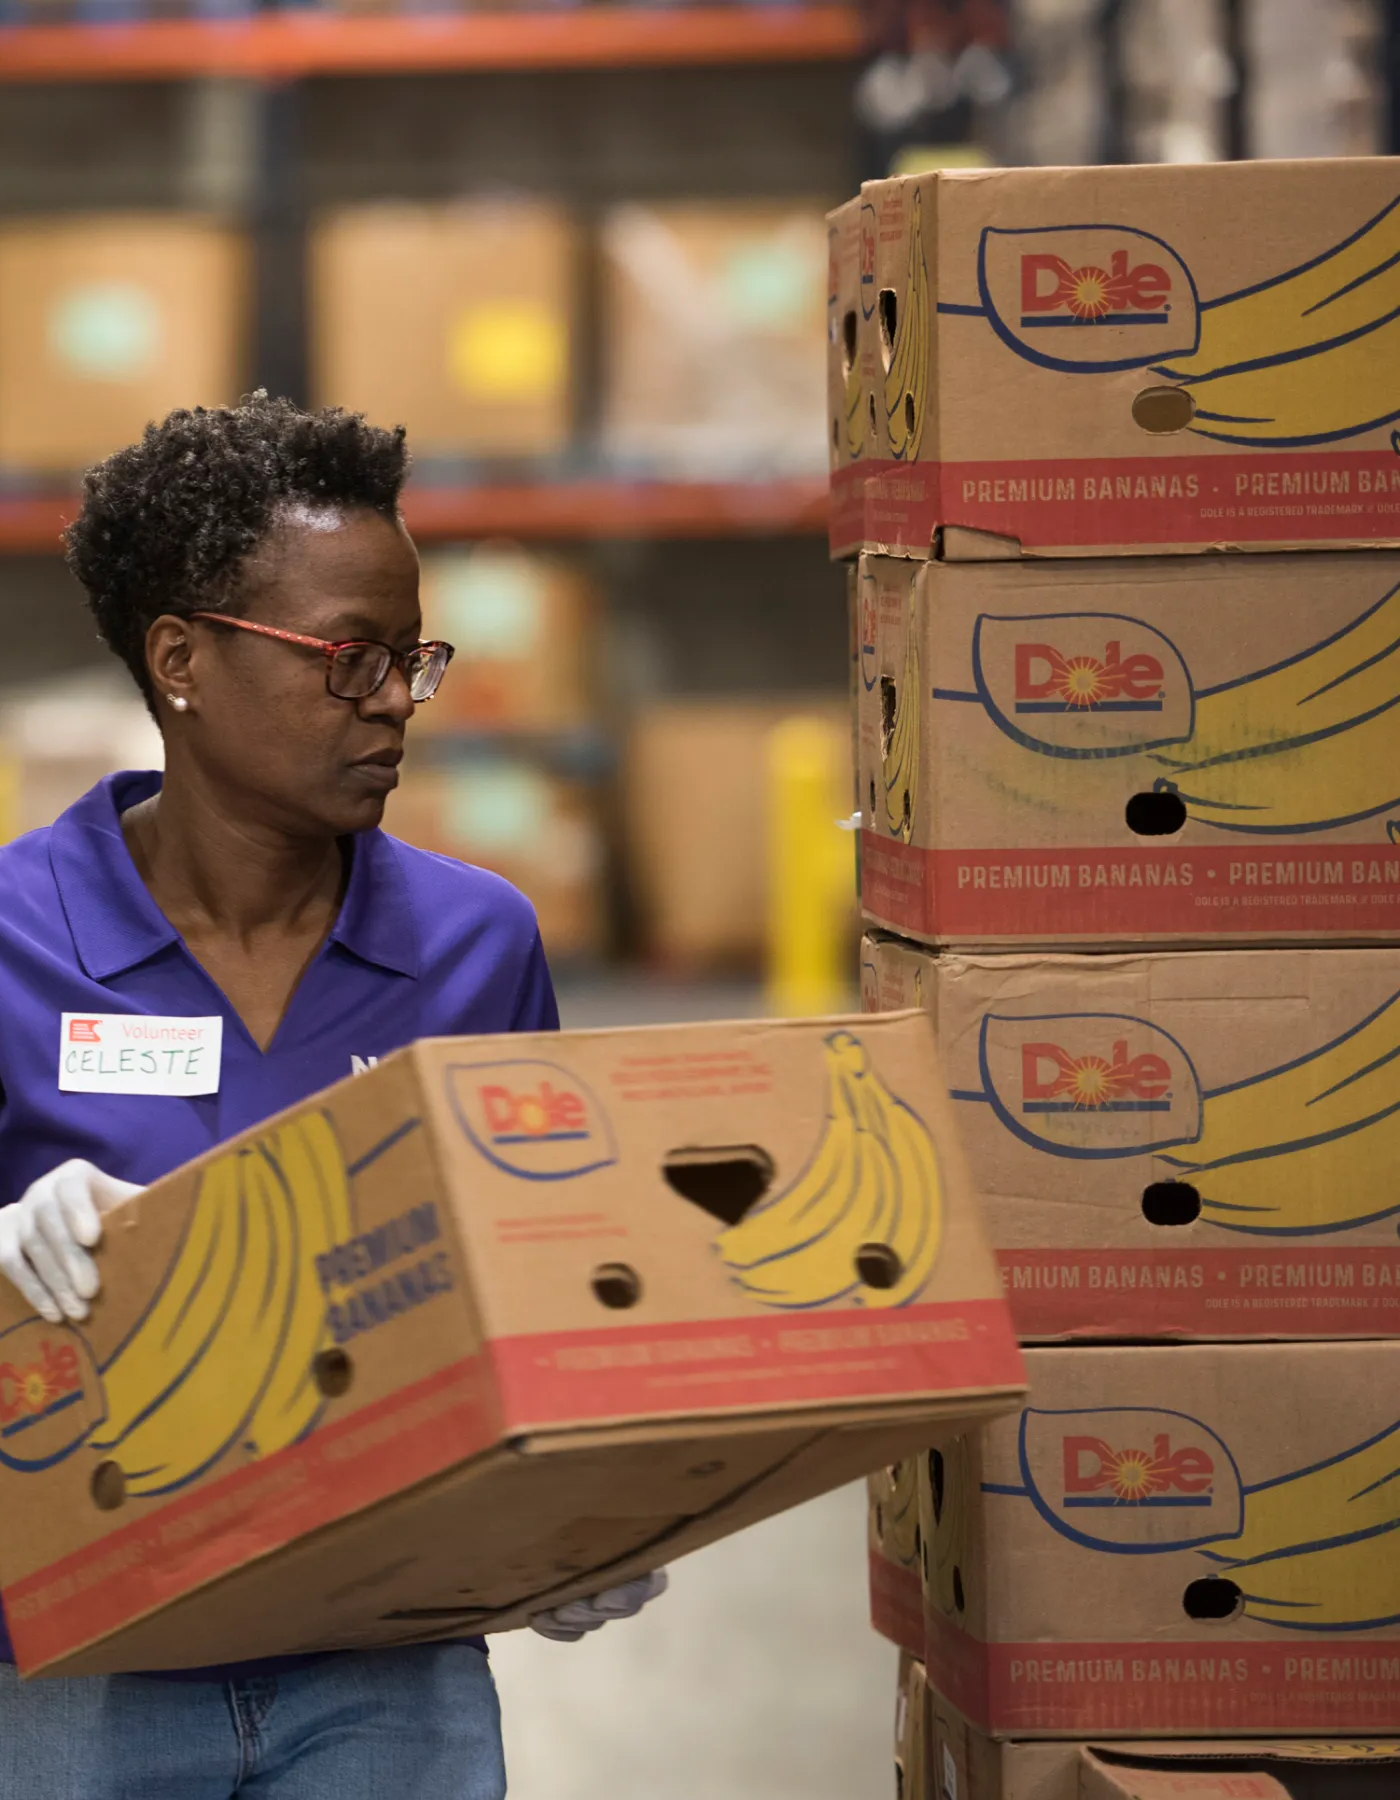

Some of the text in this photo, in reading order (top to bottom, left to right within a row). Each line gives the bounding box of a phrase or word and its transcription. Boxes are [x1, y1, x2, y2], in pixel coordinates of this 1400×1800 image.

[1020, 250, 1172, 318] Dole
[962, 478, 1076, 503] PREMIUM
[1084, 475, 1199, 500] BANANAS
[1235, 471, 1350, 496] PREMIUM
[1200, 507, 1224, 518] DOLE
[1226, 507, 1236, 518] IS
[1238, 507, 1245, 517] A
[1247, 505, 1303, 517] REGISTERED
[1306, 503, 1363, 516] TRADEMARK
[1014, 641, 1164, 706] Dole
[957, 860, 1400, 889] PREMIUM BANANAS PREMIUM BAN
[1195, 895, 1218, 906] DOLE
[1232, 895, 1239, 905] A
[1242, 894, 1298, 906] REGISTERED
[1299, 893, 1358, 905] TRADEMARK
[1371, 893, 1395, 904] DOLE
[122, 1021, 206, 1040] Volunteer
[65, 1047, 204, 1074] CELESTE
[1021, 1040, 1172, 1106] Dole
[478, 1080, 587, 1137] Dole
[1088, 1264, 1204, 1289] BANANAS
[1239, 1263, 1354, 1288] PREMIUM
[1205, 1298, 1229, 1309] DOLE
[1243, 1298, 1250, 1308] A
[1252, 1297, 1308, 1308] REGISTERED
[1311, 1297, 1368, 1308] TRADEMARK
[1062, 1434, 1214, 1501] Dole
[1009, 1656, 1400, 1683] PREMIUM BANANAS PREMIUM
